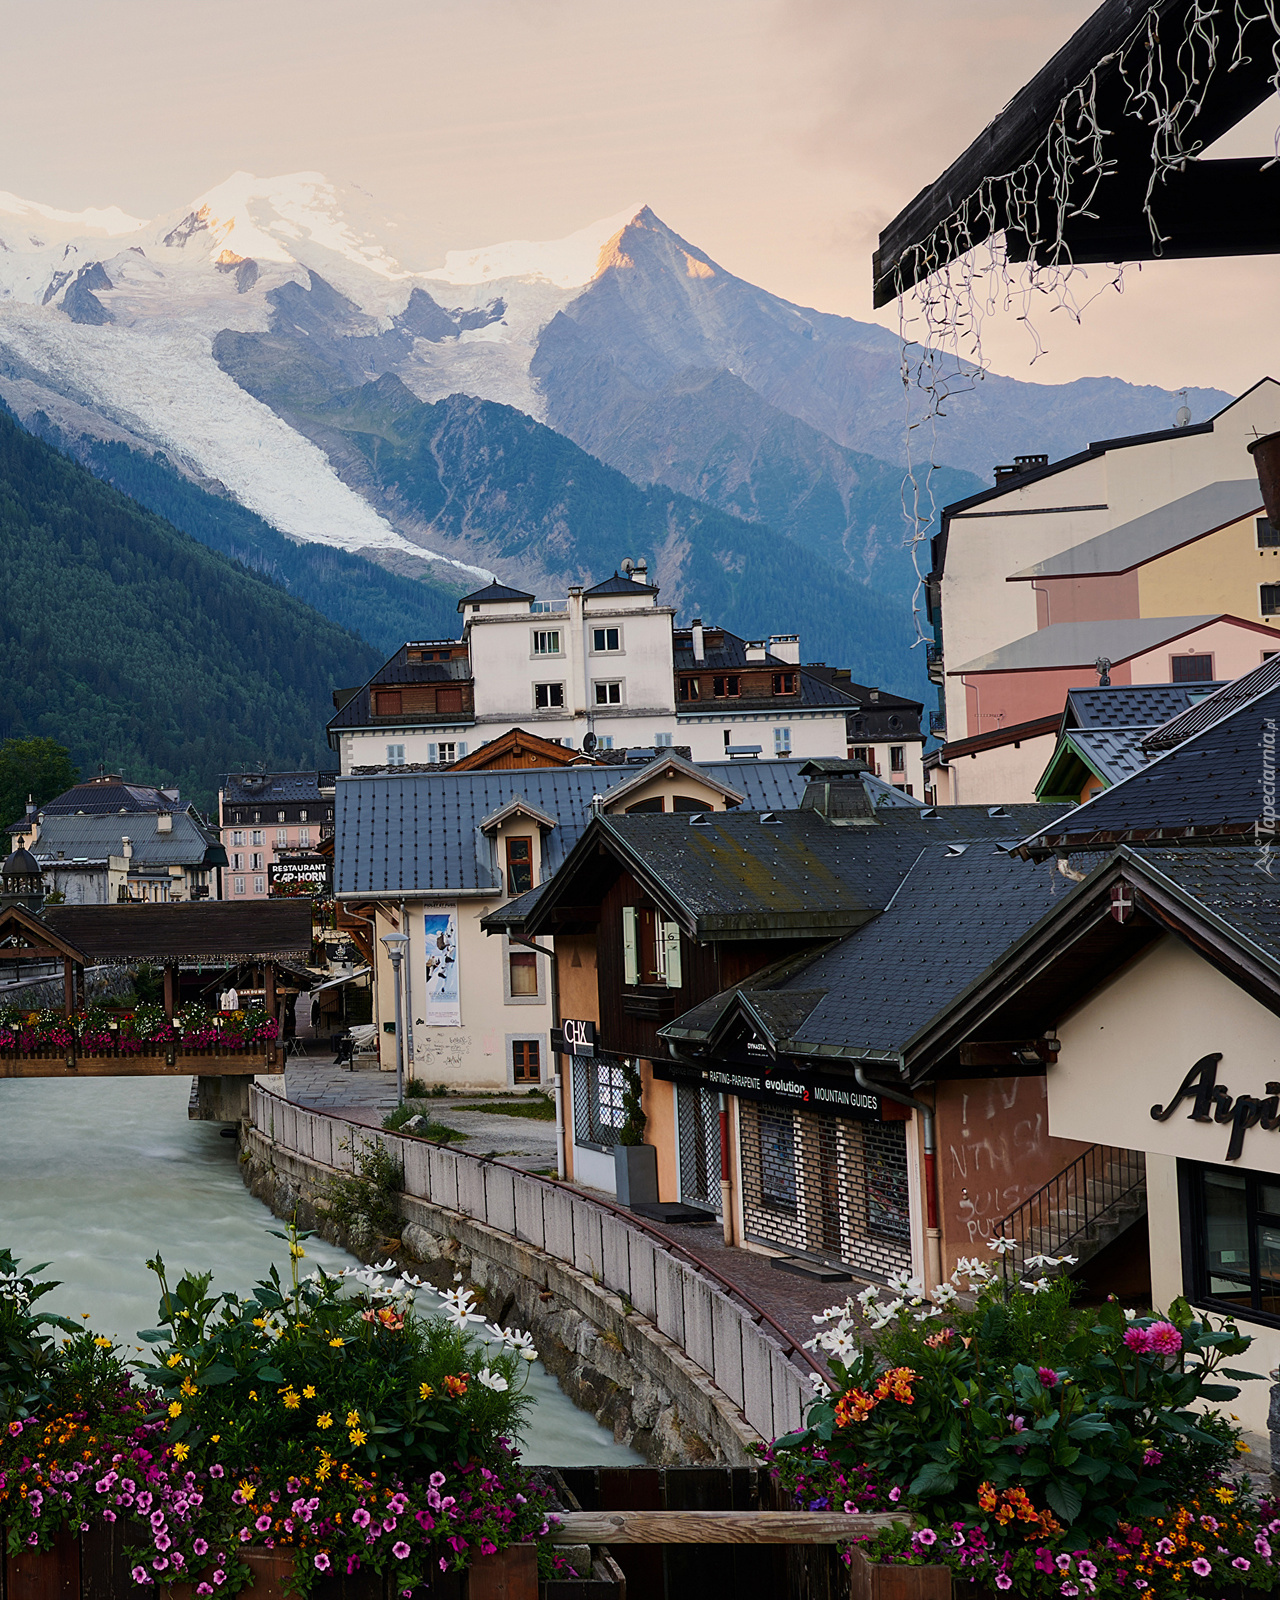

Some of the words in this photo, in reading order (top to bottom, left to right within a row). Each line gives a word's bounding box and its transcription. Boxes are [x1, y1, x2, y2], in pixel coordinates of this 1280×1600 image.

[272, 864, 326, 872] RESTAURANT
[564, 1020, 587, 1048] CHX
[747, 1042, 767, 1051] DYNASTA
[709, 1070, 761, 1090] RAFTING-PARAPENTE
[814, 1087, 850, 1105] MOUNTAIN
[850, 1092, 878, 1110] GUIDES
